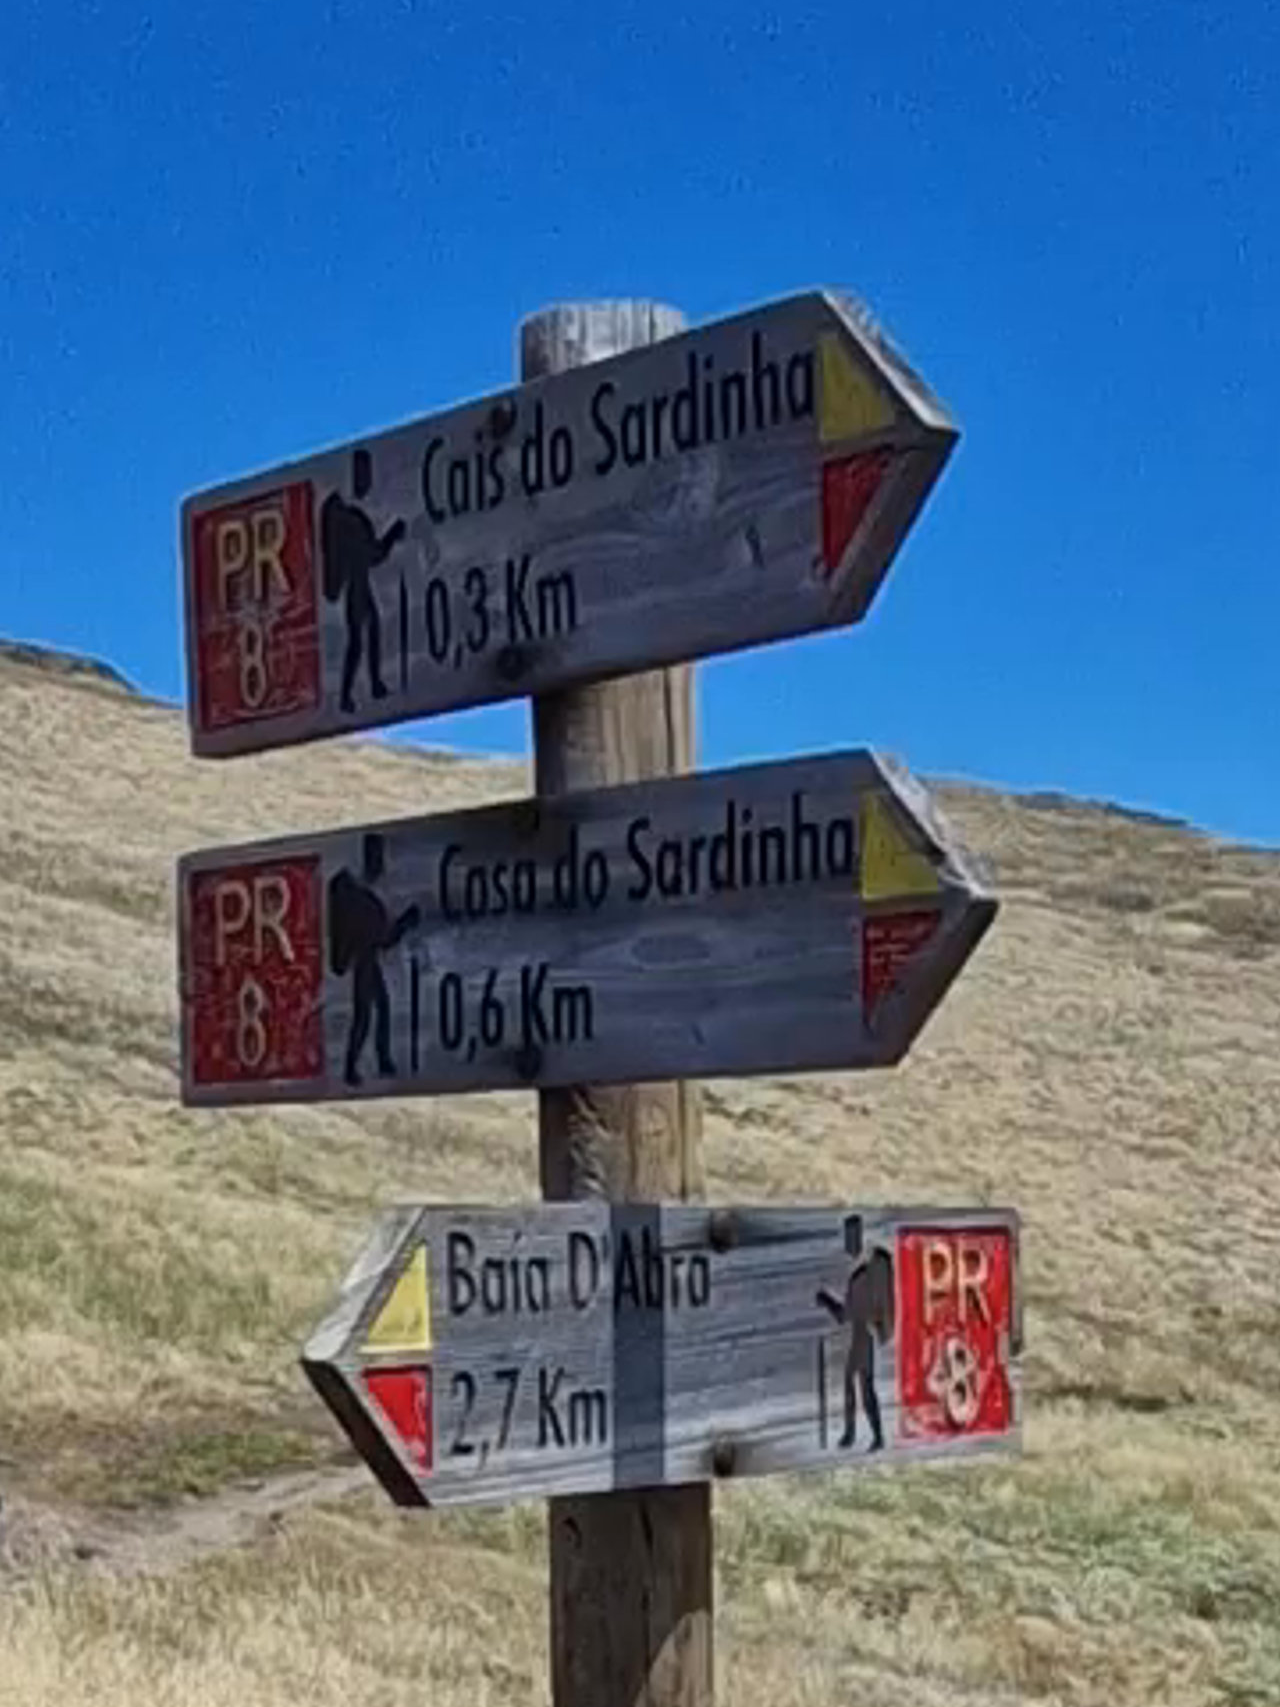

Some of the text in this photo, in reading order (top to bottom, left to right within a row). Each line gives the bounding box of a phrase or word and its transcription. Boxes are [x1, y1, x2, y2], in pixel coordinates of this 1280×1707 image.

[421, 330, 817, 526] Cais do Sardinha
[216, 511, 291, 601] PR
[425, 555, 578, 672] 0,3 Km
[238, 623, 270, 708] 8
[553, 822, 610, 910] do
[627, 793, 855, 899] Sardinha
[214, 876, 294, 966] PR
[235, 981, 268, 1070] 8
[438, 962, 593, 1063] 0,6 Km
[922, 1243, 990, 1325] PR
[448, 1367, 607, 1469] 2,7 Km
[942, 1337, 982, 1426] 8
